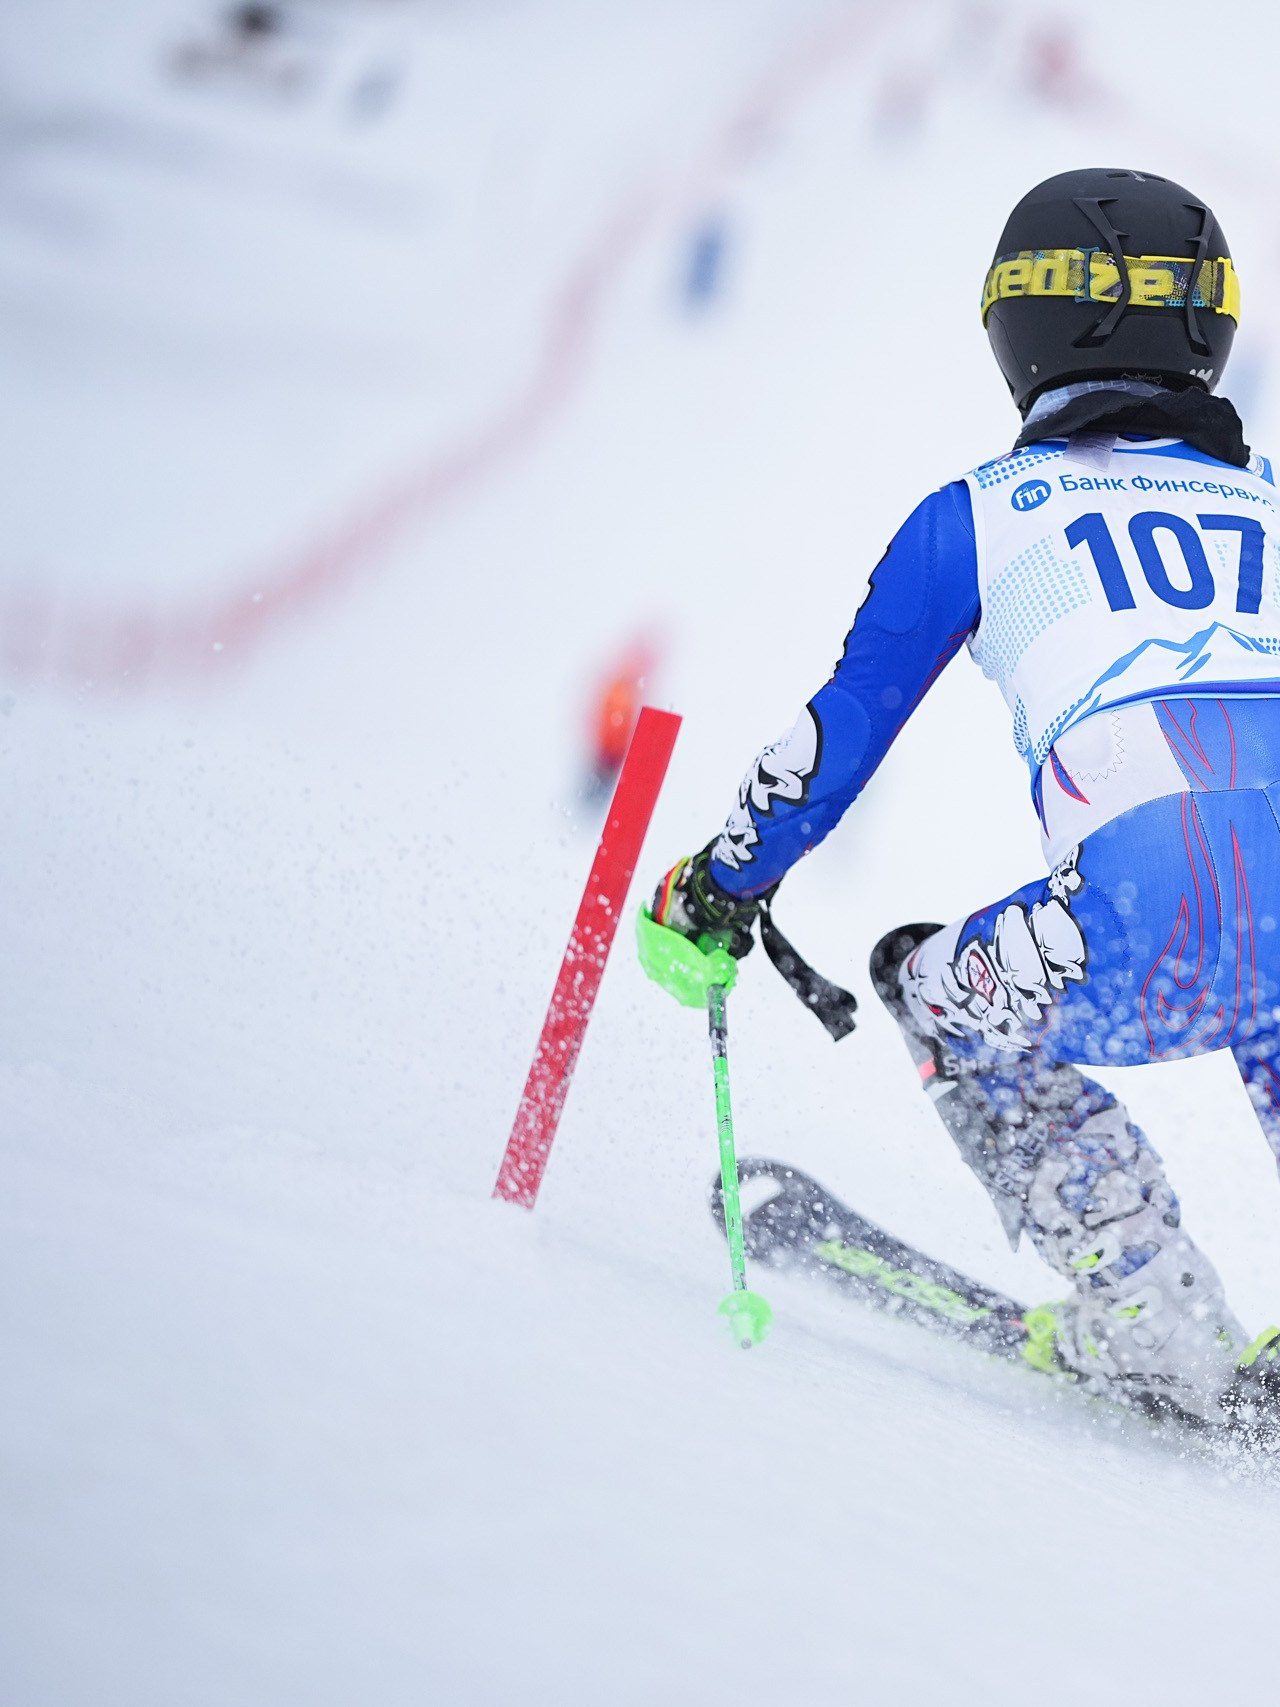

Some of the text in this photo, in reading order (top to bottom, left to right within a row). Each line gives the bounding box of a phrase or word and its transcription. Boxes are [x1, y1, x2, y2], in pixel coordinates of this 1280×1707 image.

[1059, 474, 1128, 492] Банк
[1015, 485, 1049, 509] fin
[1064, 511, 1266, 615] 107
